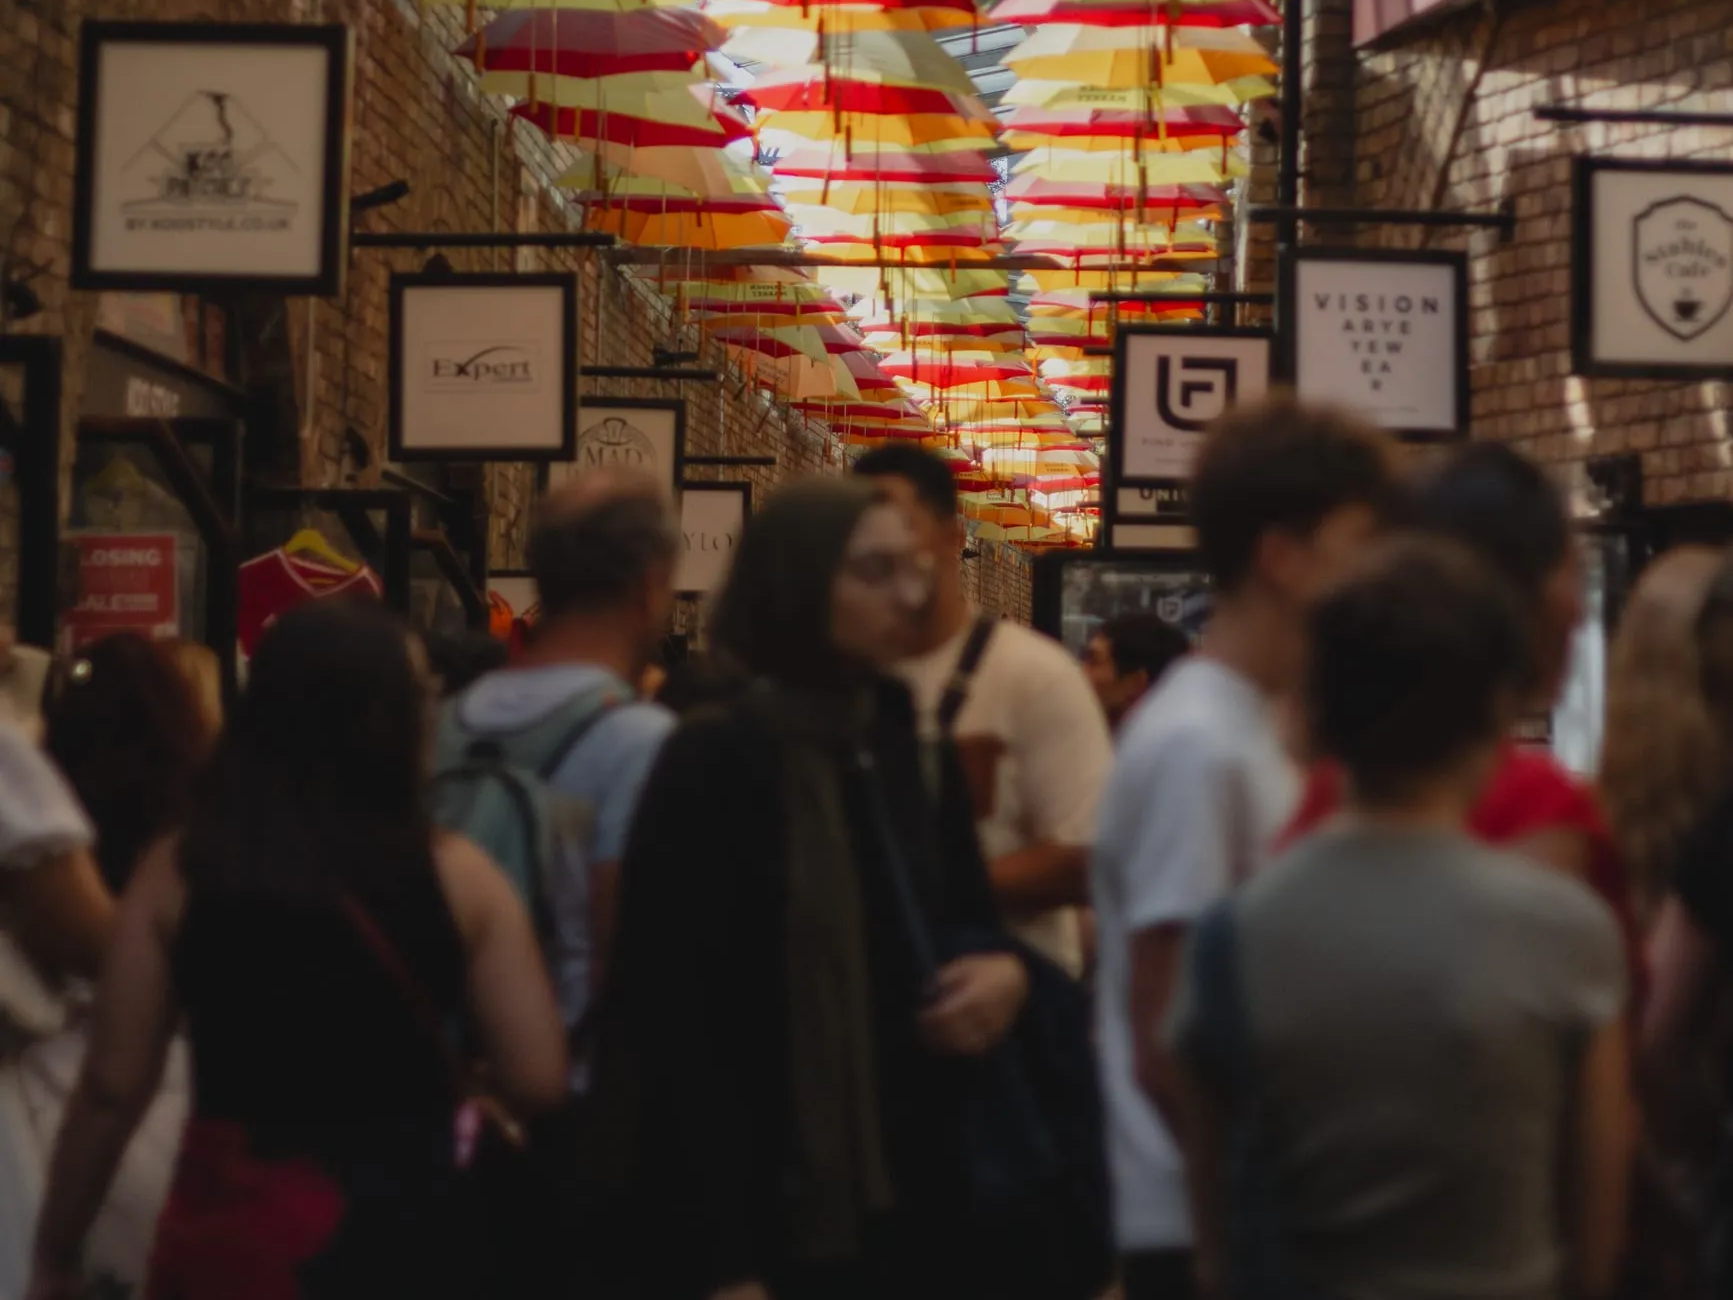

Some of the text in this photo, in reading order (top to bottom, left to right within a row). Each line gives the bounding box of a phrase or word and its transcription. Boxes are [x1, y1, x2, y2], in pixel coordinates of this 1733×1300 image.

[1313, 293, 1439, 314] VISION
[1342, 318, 1411, 335] ARYE
[1352, 340, 1403, 354] YEW
[432, 354, 531, 381] Expert
